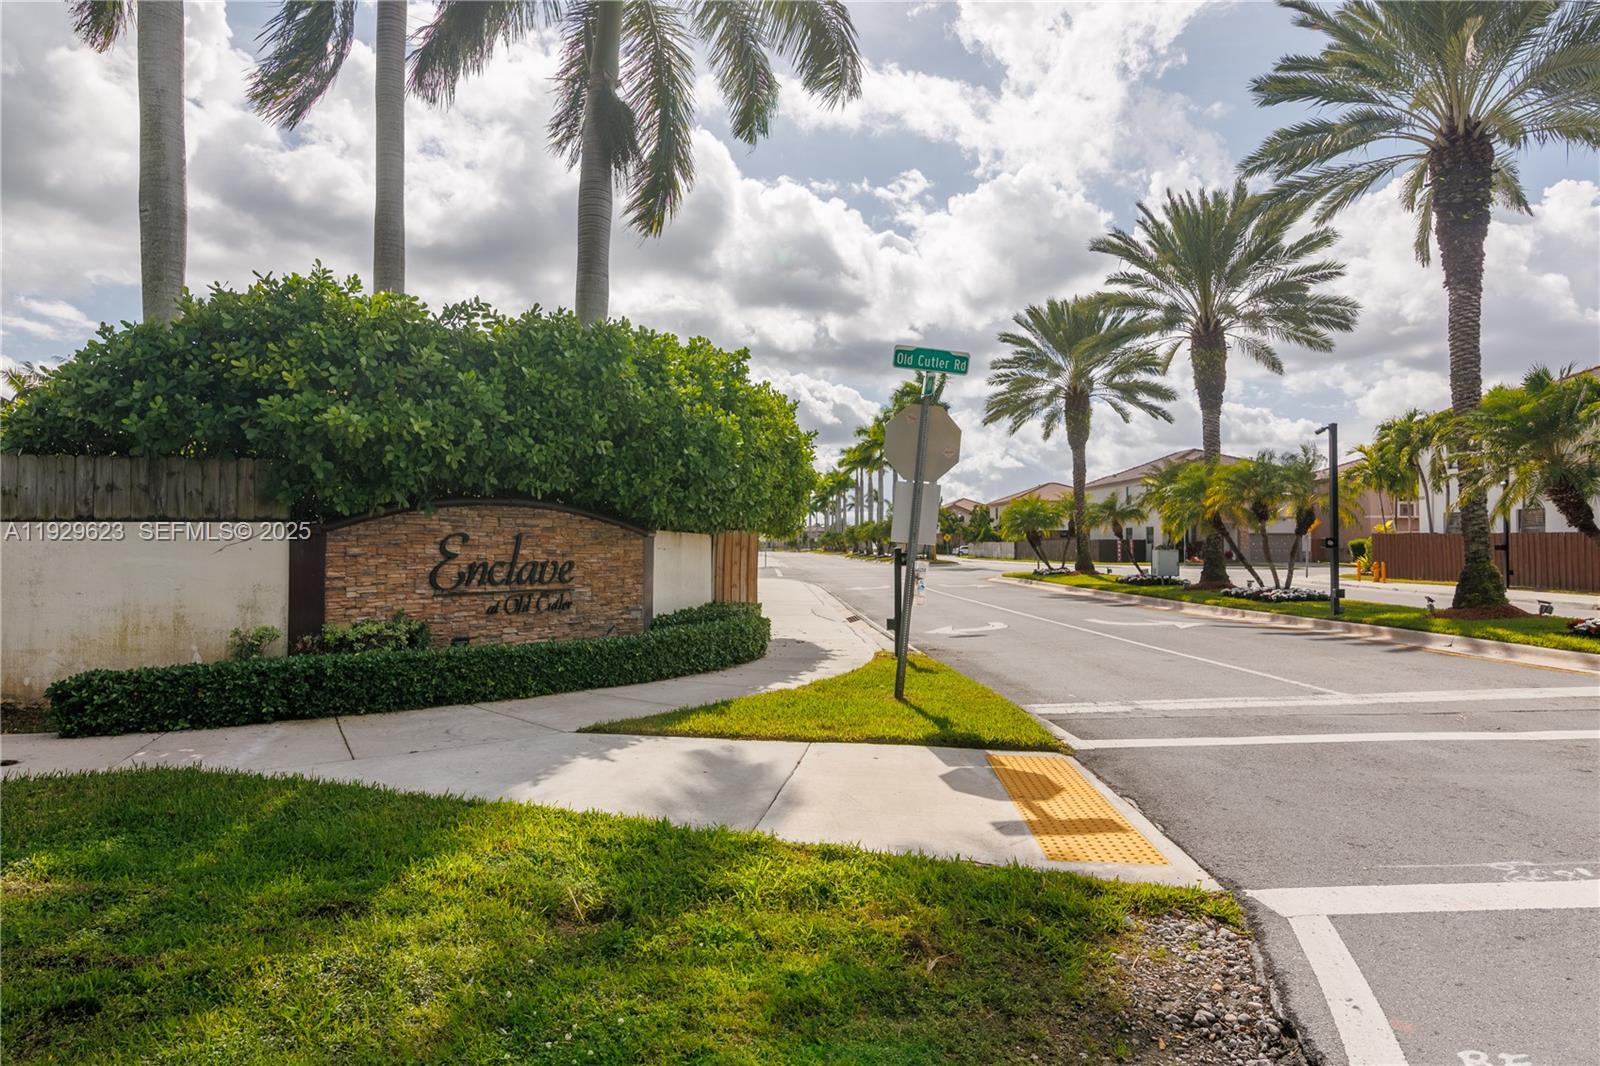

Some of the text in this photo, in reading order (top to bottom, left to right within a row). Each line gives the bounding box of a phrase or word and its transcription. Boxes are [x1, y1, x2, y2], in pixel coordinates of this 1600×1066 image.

[896, 352, 967, 372] Old Cutler Rd
[429, 532, 575, 591] Enclave
[486, 591, 573, 615] at Old Cutler
